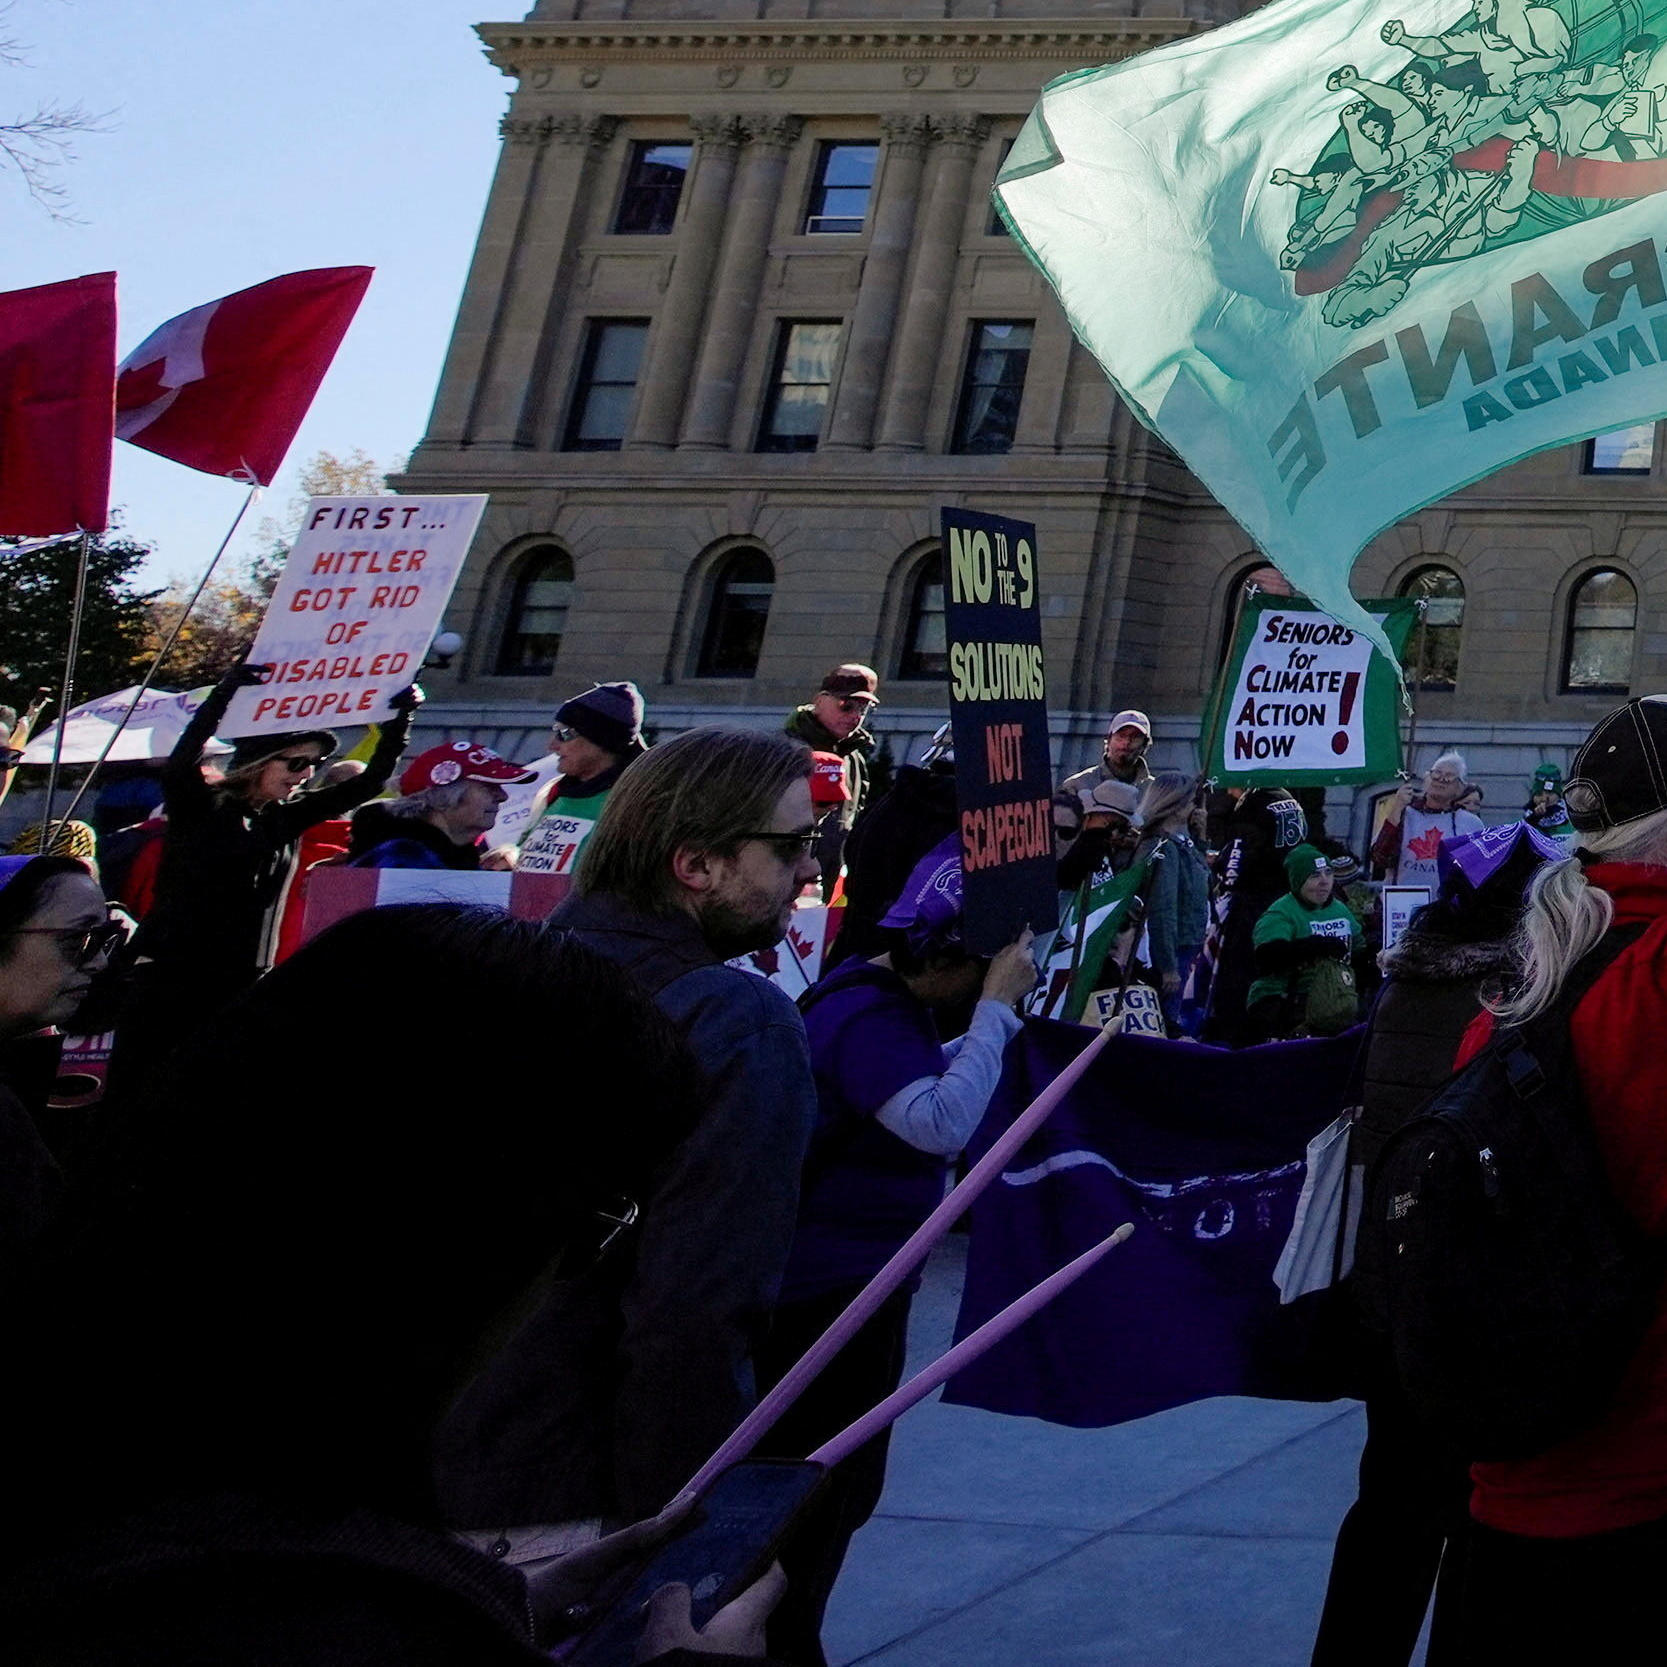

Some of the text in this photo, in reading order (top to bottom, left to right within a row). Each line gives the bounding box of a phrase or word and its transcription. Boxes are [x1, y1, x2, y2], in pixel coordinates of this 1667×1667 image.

[309, 507, 445, 530] FIRST...
[312, 550, 427, 574] HITLER
[950, 527, 1034, 609] NO TO 9
[290, 585, 420, 612] GOT RID
[997, 569, 1016, 605] THE
[326, 621, 368, 645] OF
[261, 653, 409, 684] DISABLED
[951, 642, 1044, 702] SOLUTIONS
[1287, 647, 1318, 670] for
[1247, 665, 1341, 693] CLIMATE
[253, 689, 378, 721] PEOPLE
[1235, 697, 1326, 727] ACTION
[986, 724, 1023, 784] NOT
[1234, 730, 1296, 760] NOW
[962, 798, 1052, 873] SCAPEGOAT
[1403, 859, 1438, 873] CANA
